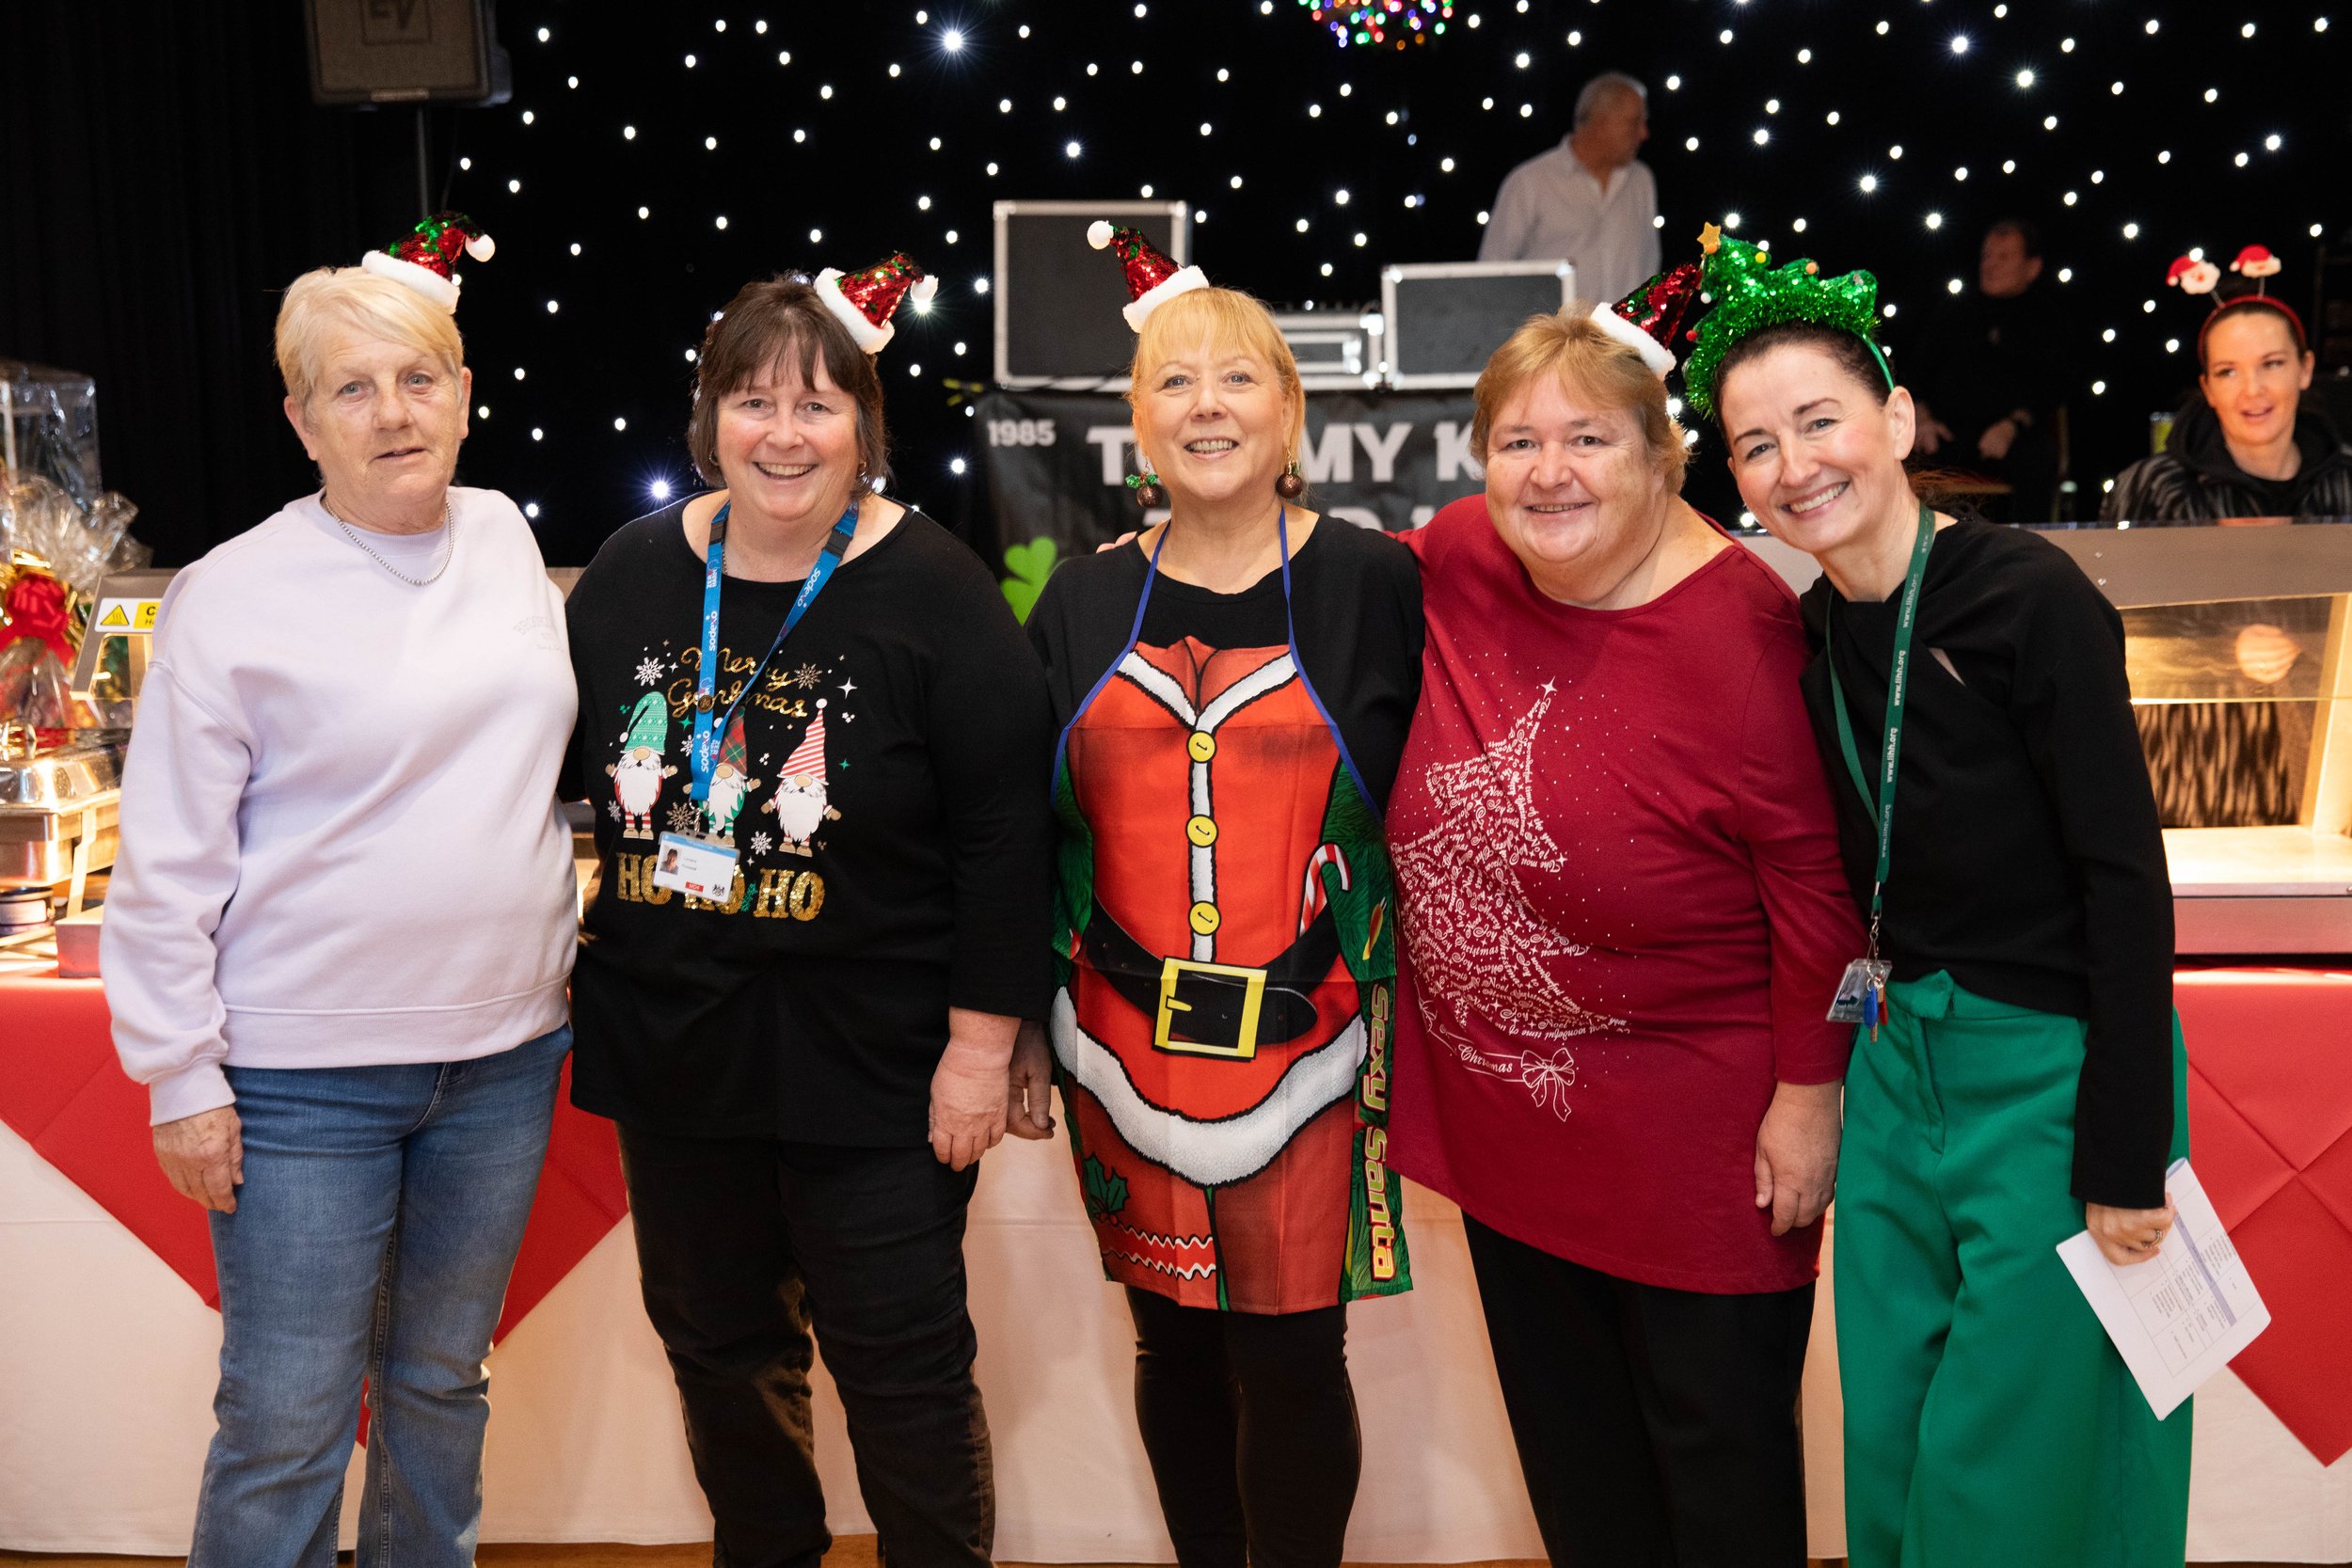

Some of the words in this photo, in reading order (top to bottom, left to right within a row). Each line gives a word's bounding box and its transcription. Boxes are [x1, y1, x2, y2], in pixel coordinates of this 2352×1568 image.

[988, 420, 1057, 447] 1985
[1086, 421, 1412, 486] TMY
[797, 566, 821, 608] sodexo
[707, 610, 718, 652] sodexo
[696, 730, 711, 773] sodexo
[1486, 799, 1507, 817] Joy
[1524, 832, 1550, 860] Noel
[754, 867, 825, 922] HO
[1454, 932, 1499, 958] Christmas
[1472, 924, 1498, 942] Joy
[1482, 976, 1509, 992] Noel
[1500, 1006, 1530, 1022] Joy
[1363, 983, 1389, 1113] Sexy
[1364, 1126, 1395, 1281] Santa
